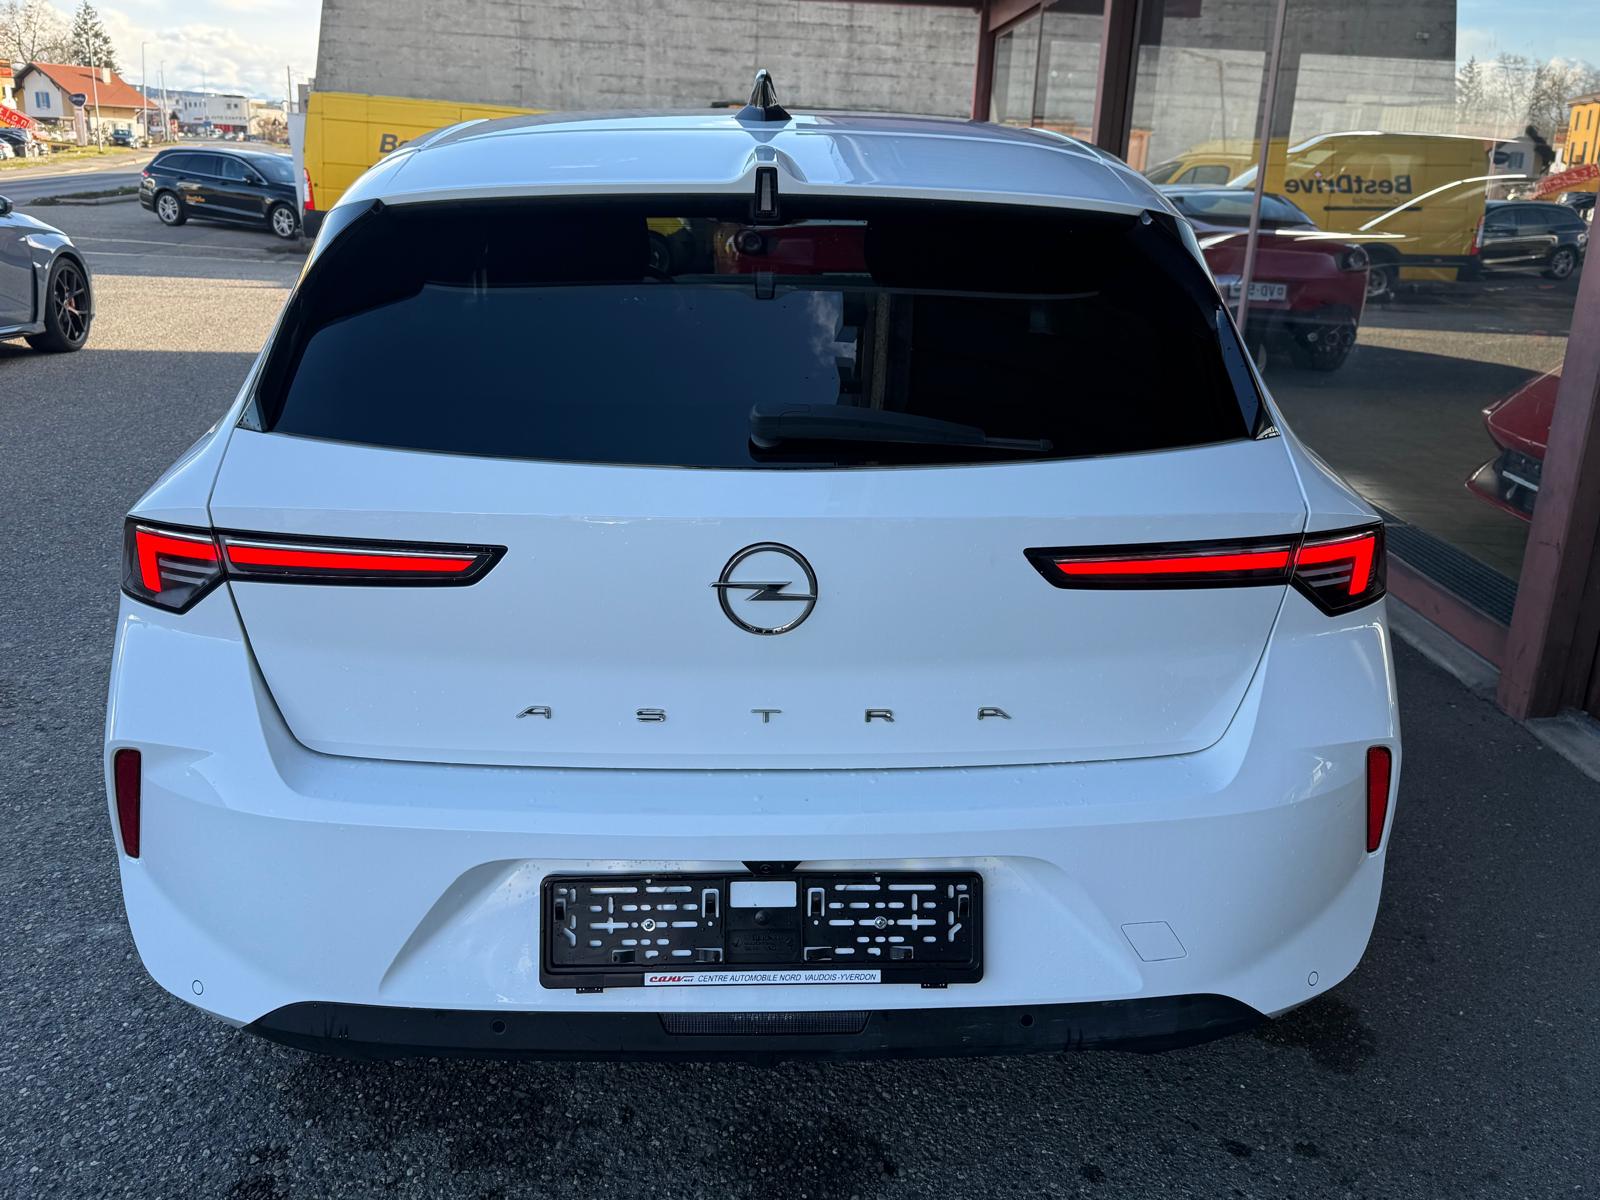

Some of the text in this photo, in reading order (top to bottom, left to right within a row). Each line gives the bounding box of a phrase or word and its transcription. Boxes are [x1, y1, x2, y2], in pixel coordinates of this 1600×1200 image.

[516, 705, 1012, 723] ASTRA
[697, 974, 731, 982] CENTRE
[731, 973, 777, 982] AUTOMOBILE
[779, 973, 802, 981] NORD
